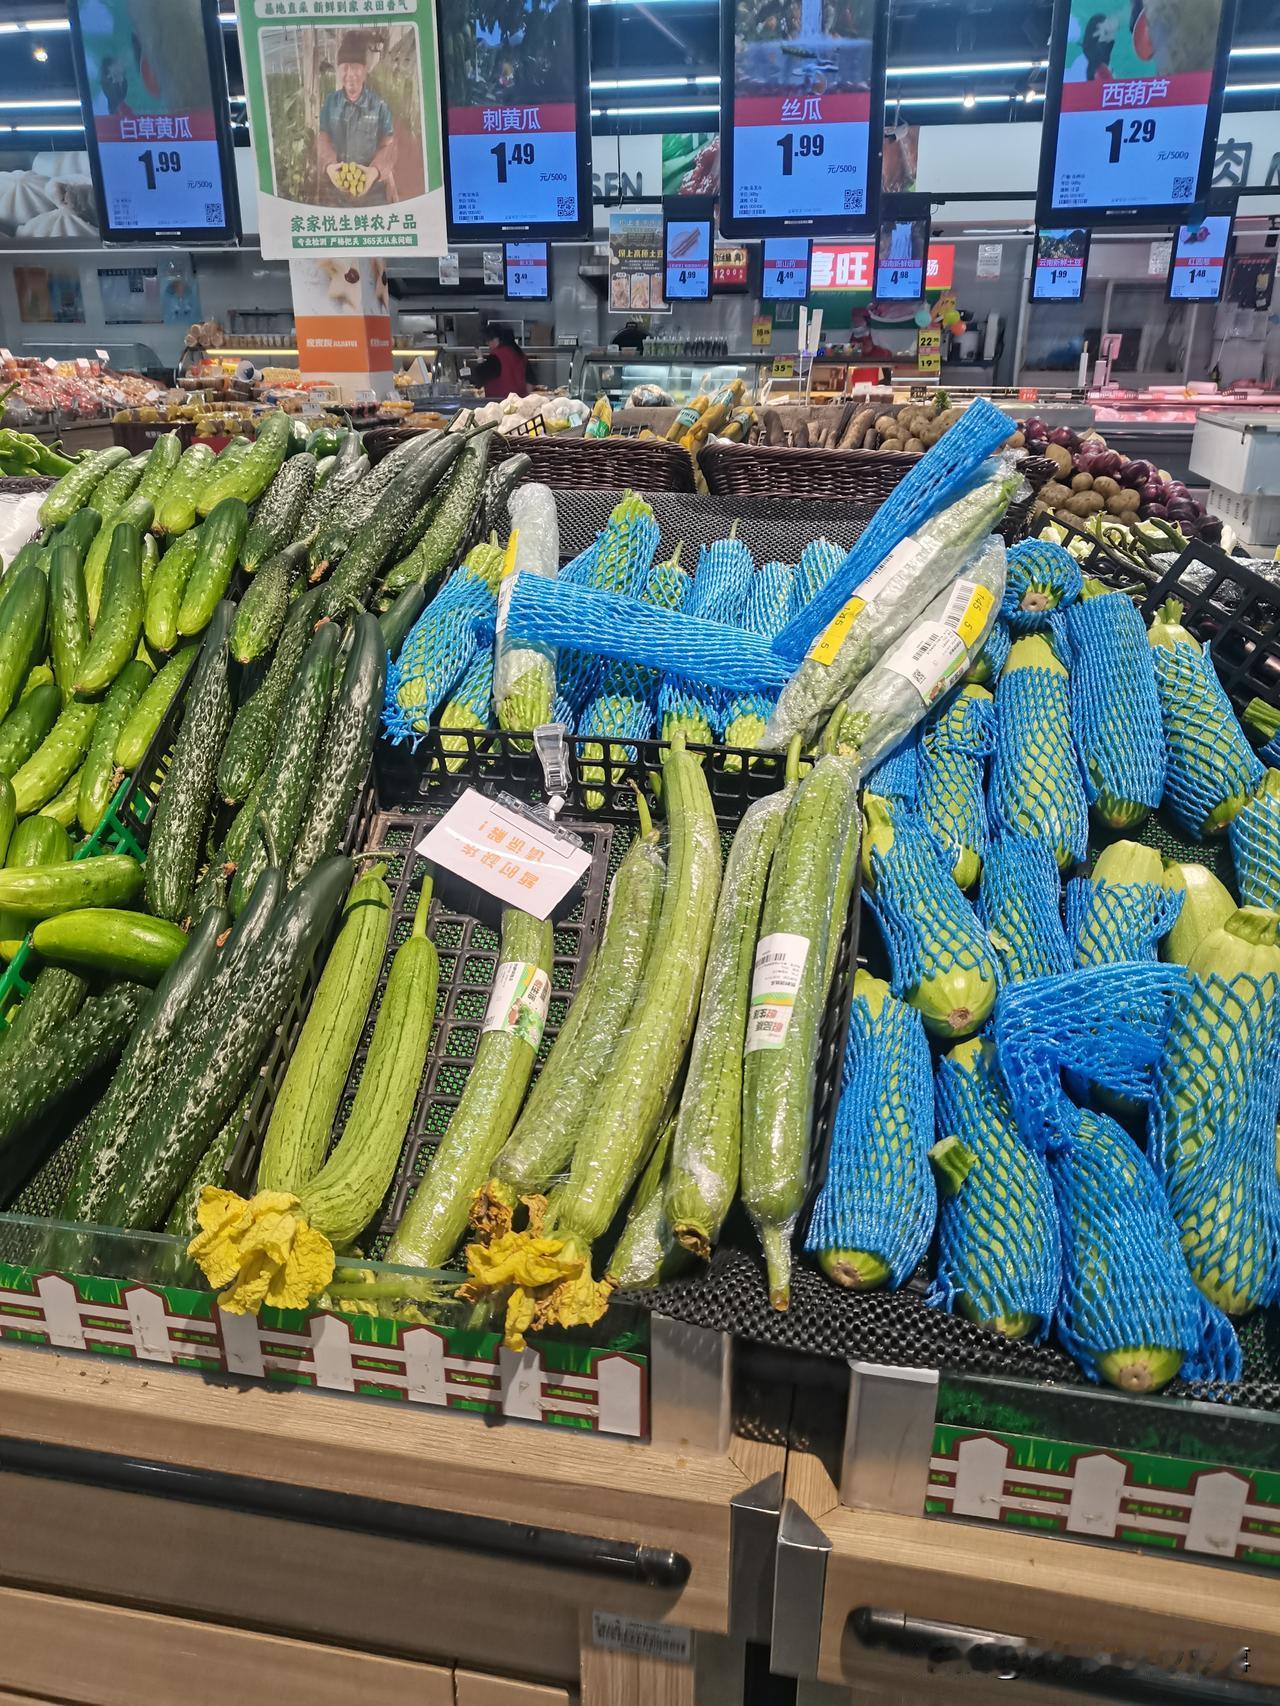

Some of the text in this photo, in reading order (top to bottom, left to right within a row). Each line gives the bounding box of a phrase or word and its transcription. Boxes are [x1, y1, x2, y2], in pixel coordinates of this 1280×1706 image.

[314, 0, 358, 13] 新鲜到家
[363, 0, 408, 11] 农田香气
[1102, 79, 1170, 107] 西葫芦
[483, 107, 541, 131] 刺黄瓜
[781, 97, 822, 121] 丝瓜
[120, 116, 193, 140] 白草黄瓜
[1105, 118, 1156, 163] 1.29
[490, 142, 535, 183] 1.49
[776, 133, 824, 175] 1.99
[1156, 151, 1190, 161] 元/500g
[1211, 138, 1252, 187] 肉
[138, 150, 181, 190] 1.99
[539, 172, 567, 182] 元/500g
[827, 164, 857, 174] 元/500g
[187, 181, 213, 189] 元/500g
[291, 213, 417, 232] 家家悦生鲜农产品
[297, 237, 327, 247] 专业检测
[330, 236, 360, 246] 严格把关
[462, 842, 540, 889] 暂时缺货
